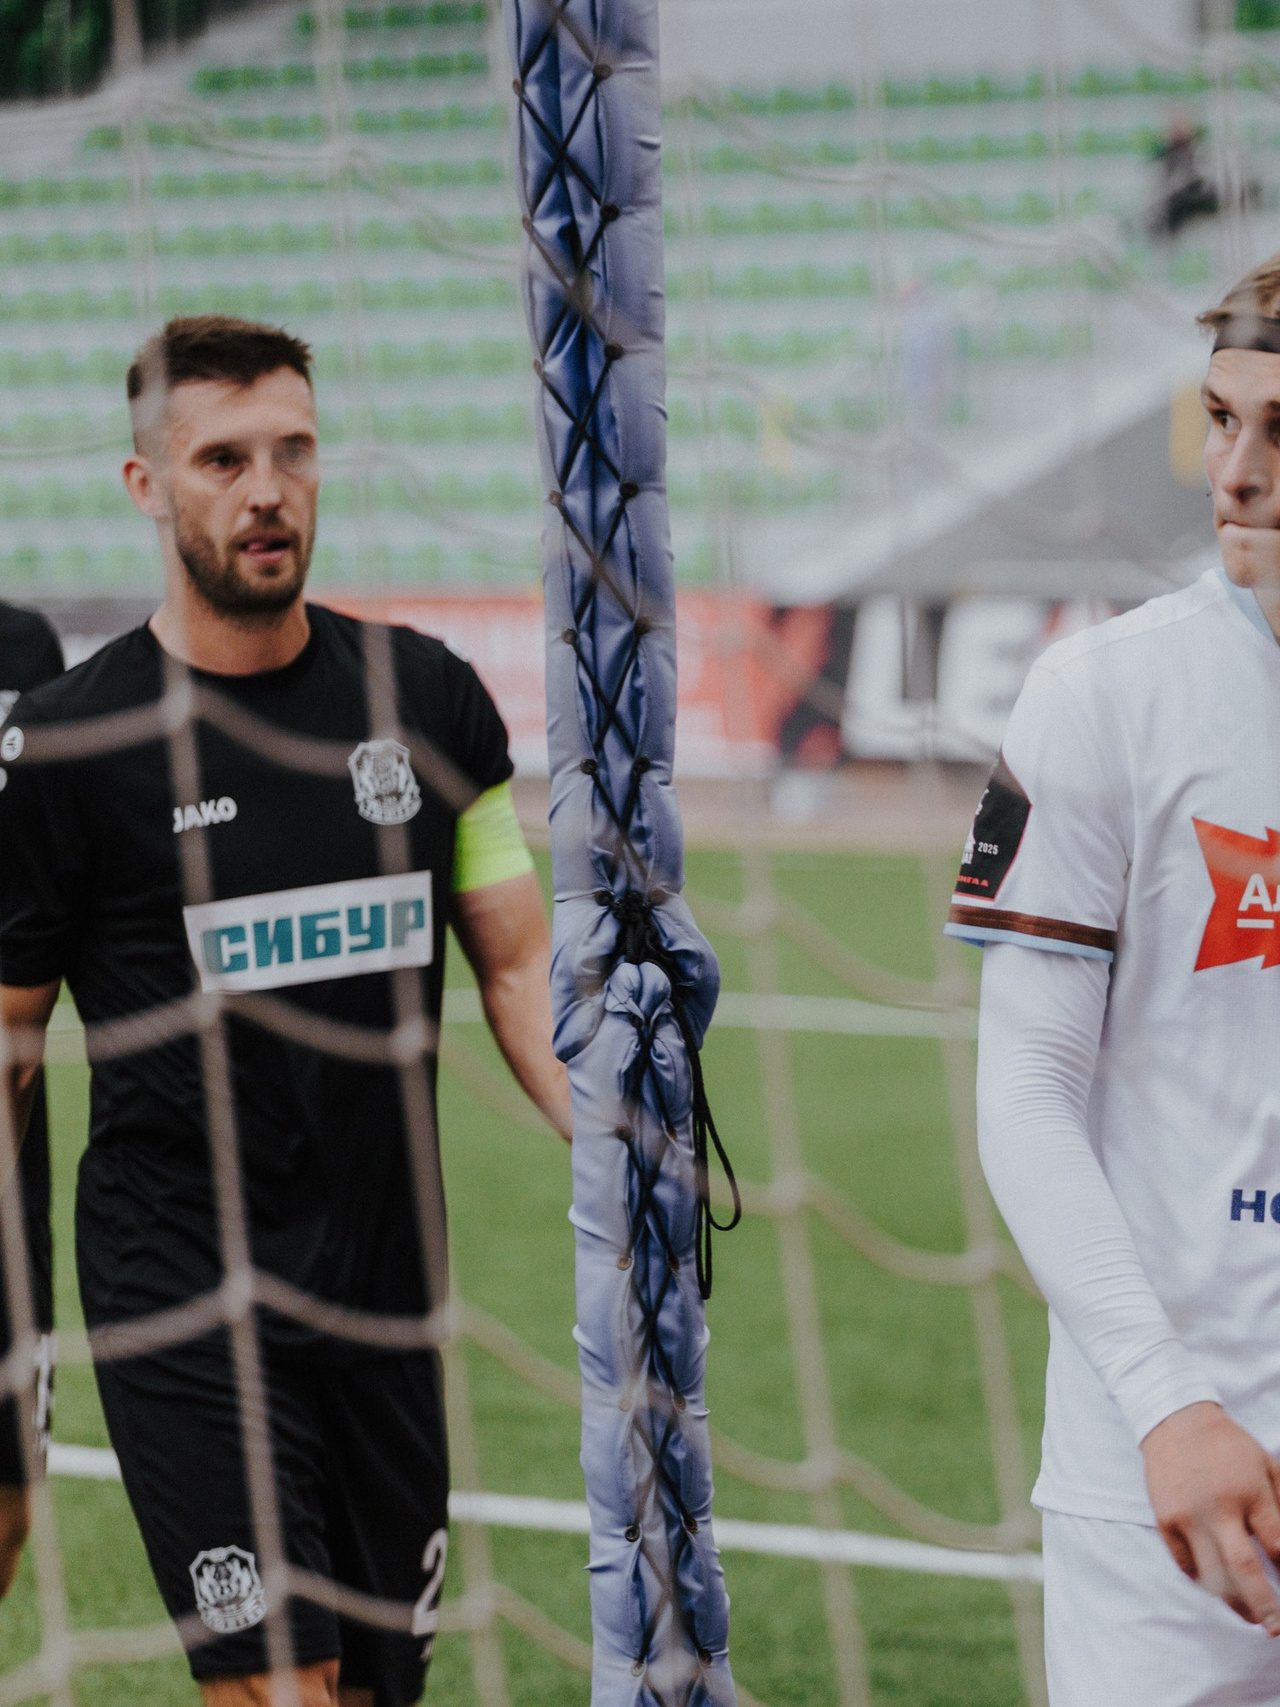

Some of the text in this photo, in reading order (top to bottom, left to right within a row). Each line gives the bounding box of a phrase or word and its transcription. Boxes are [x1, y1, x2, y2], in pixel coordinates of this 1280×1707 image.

[172, 796, 238, 833] JAKO
[977, 841, 999, 855] 2025
[202, 898, 425, 974] СИБУР
